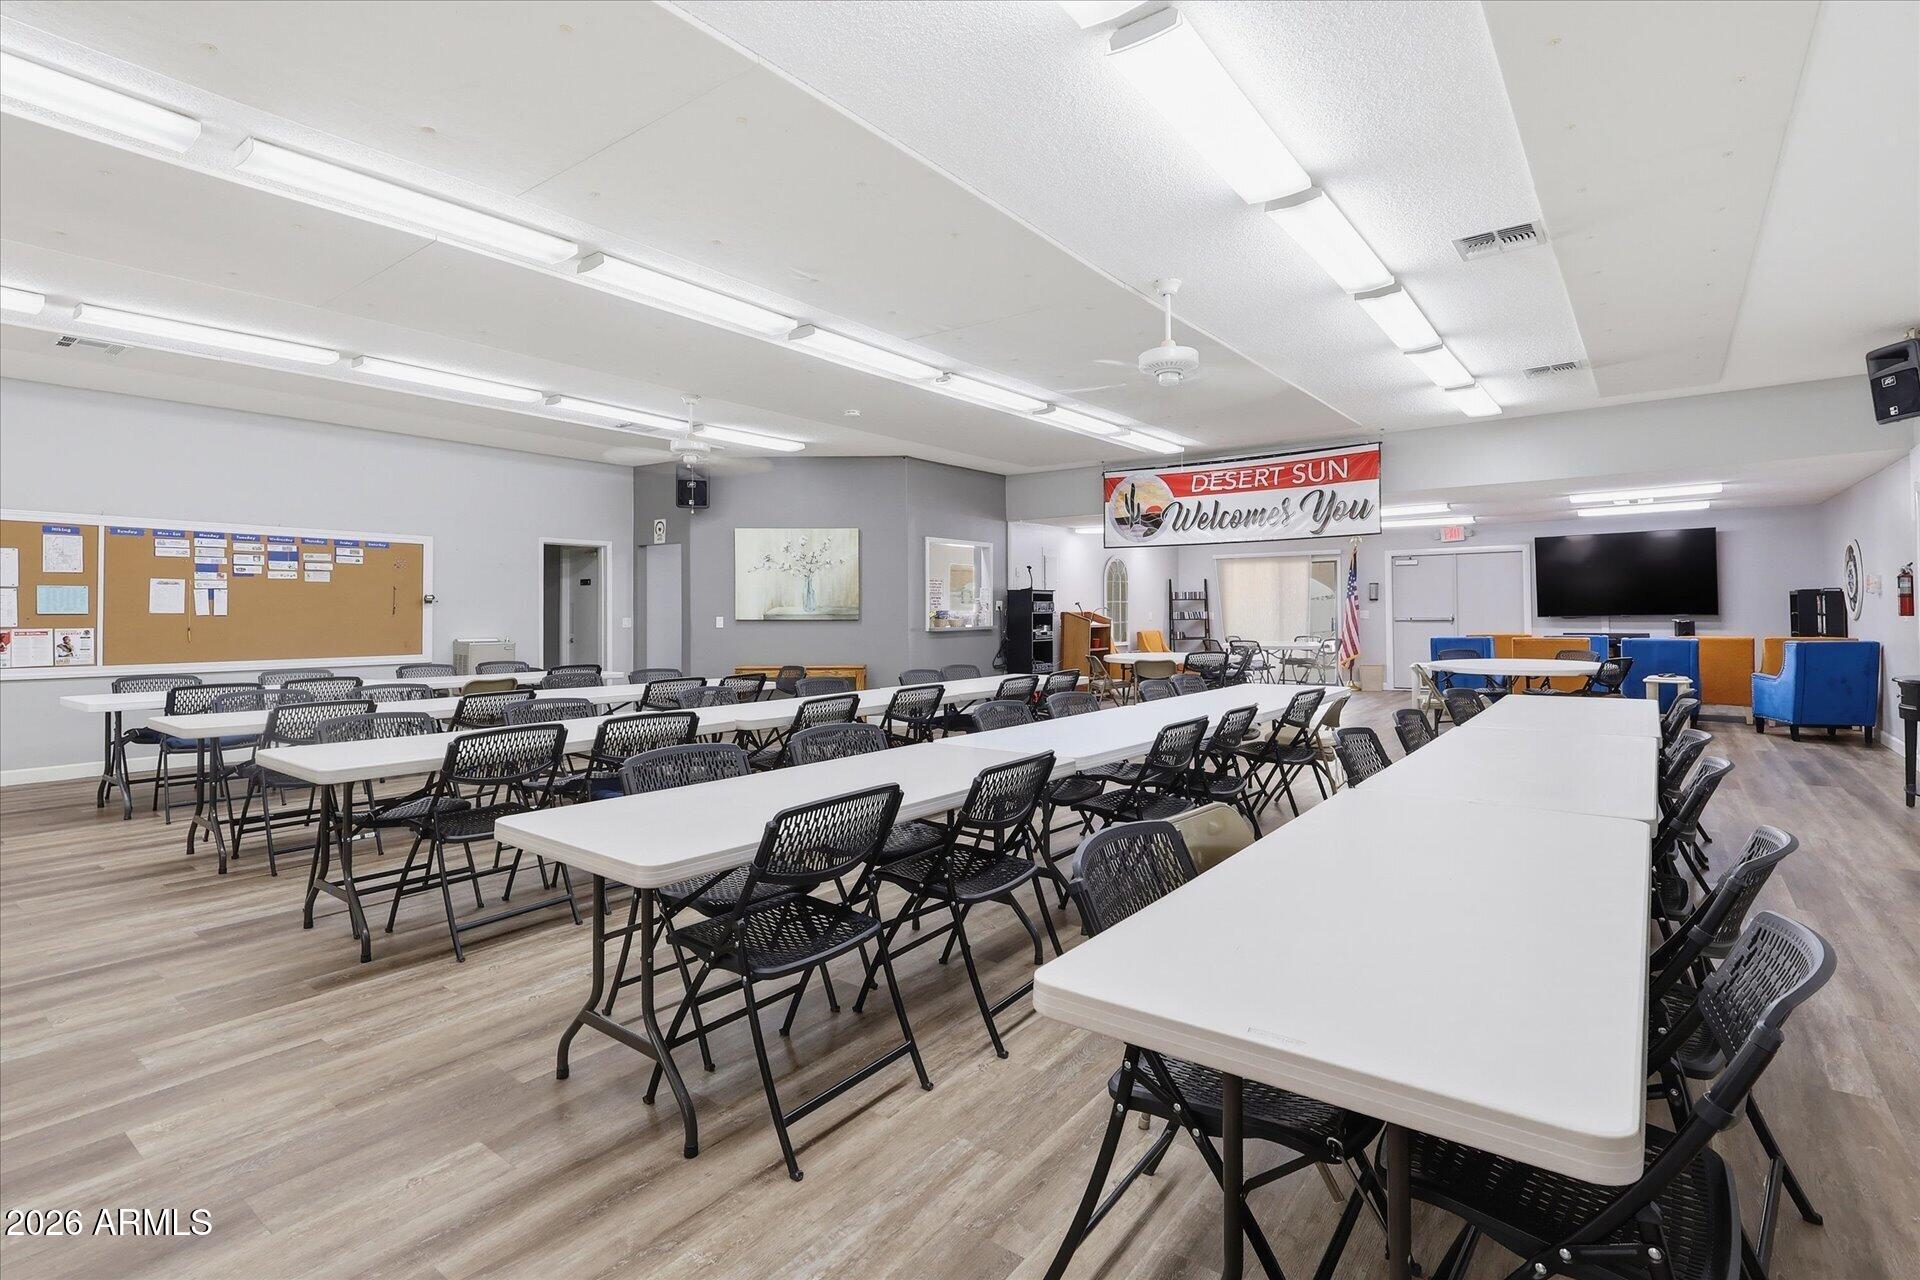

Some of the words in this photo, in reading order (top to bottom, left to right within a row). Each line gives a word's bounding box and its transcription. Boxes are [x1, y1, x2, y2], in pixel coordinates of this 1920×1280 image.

[1191, 466, 1284, 493] DESERT
[1292, 458, 1348, 484] SUN
[1162, 496, 1296, 532] Welcomes
[1300, 489, 1374, 535] You
